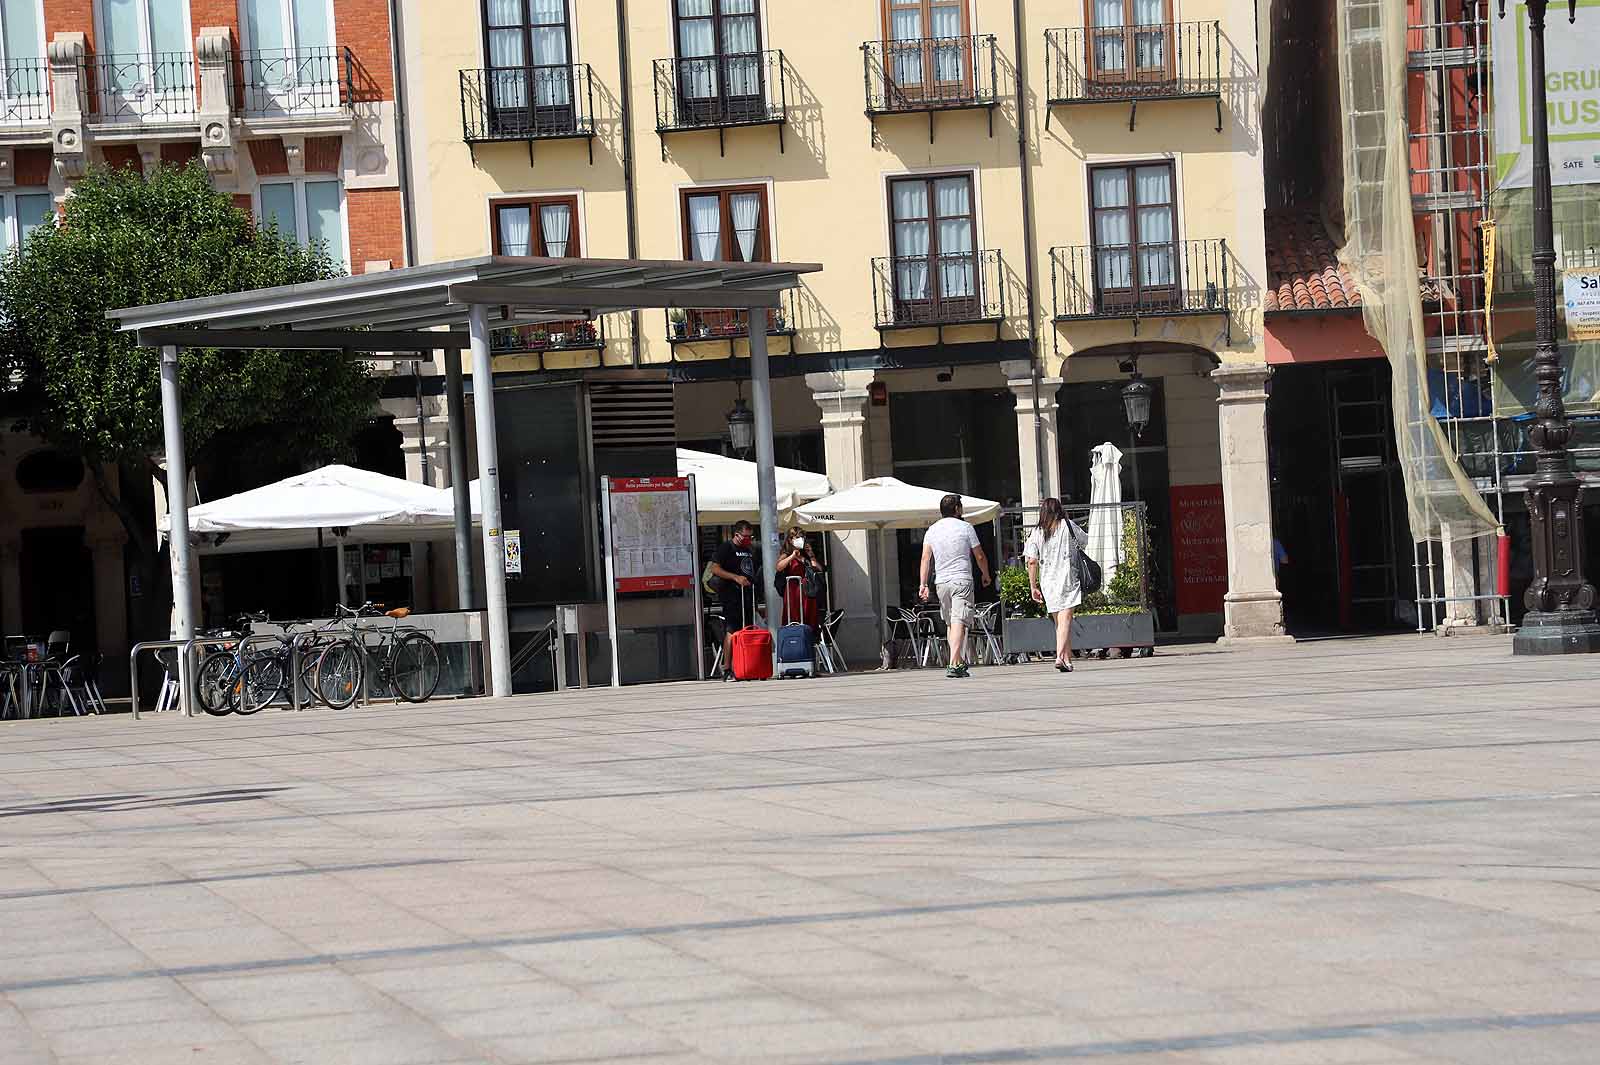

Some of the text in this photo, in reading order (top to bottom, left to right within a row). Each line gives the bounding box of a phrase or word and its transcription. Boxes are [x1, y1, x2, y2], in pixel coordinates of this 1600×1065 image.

[1545, 71, 1600, 92] GRU
[1563, 160, 1584, 169] SATE
[1580, 275, 1600, 289] Sa
